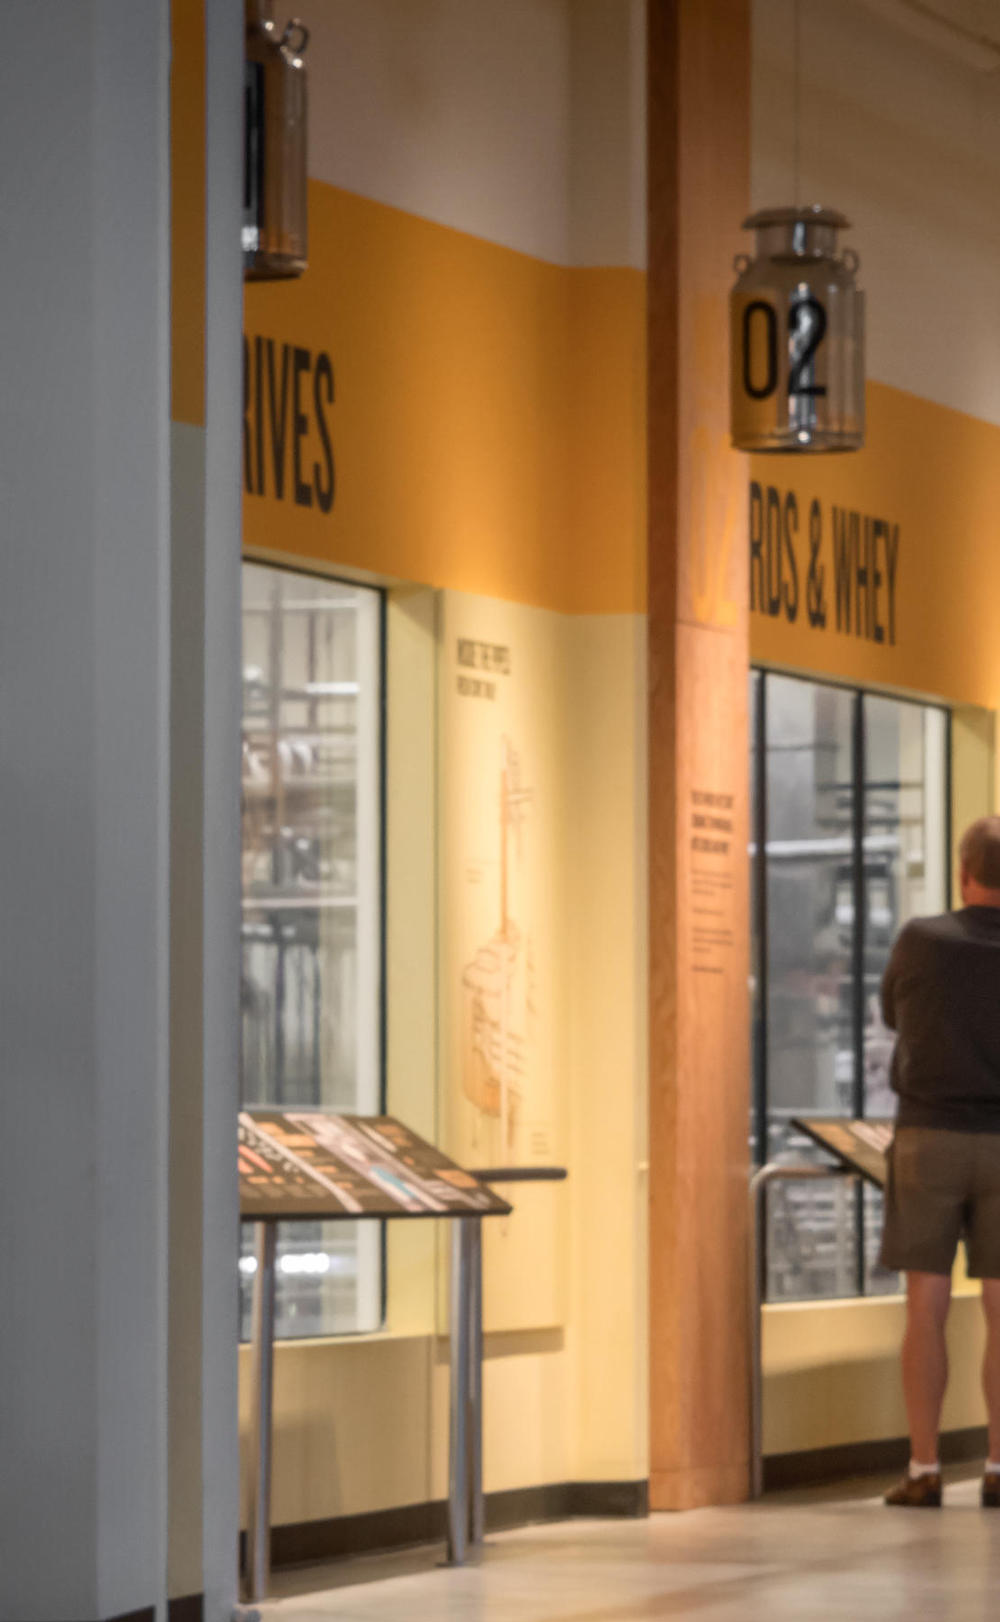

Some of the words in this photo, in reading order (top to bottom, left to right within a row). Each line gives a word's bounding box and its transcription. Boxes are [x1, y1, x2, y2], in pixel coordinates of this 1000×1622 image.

[741, 299, 828, 401] 02
[750, 480, 799, 624] RDS
[807, 497, 827, 631] &
[832, 504, 900, 647] WHEY
